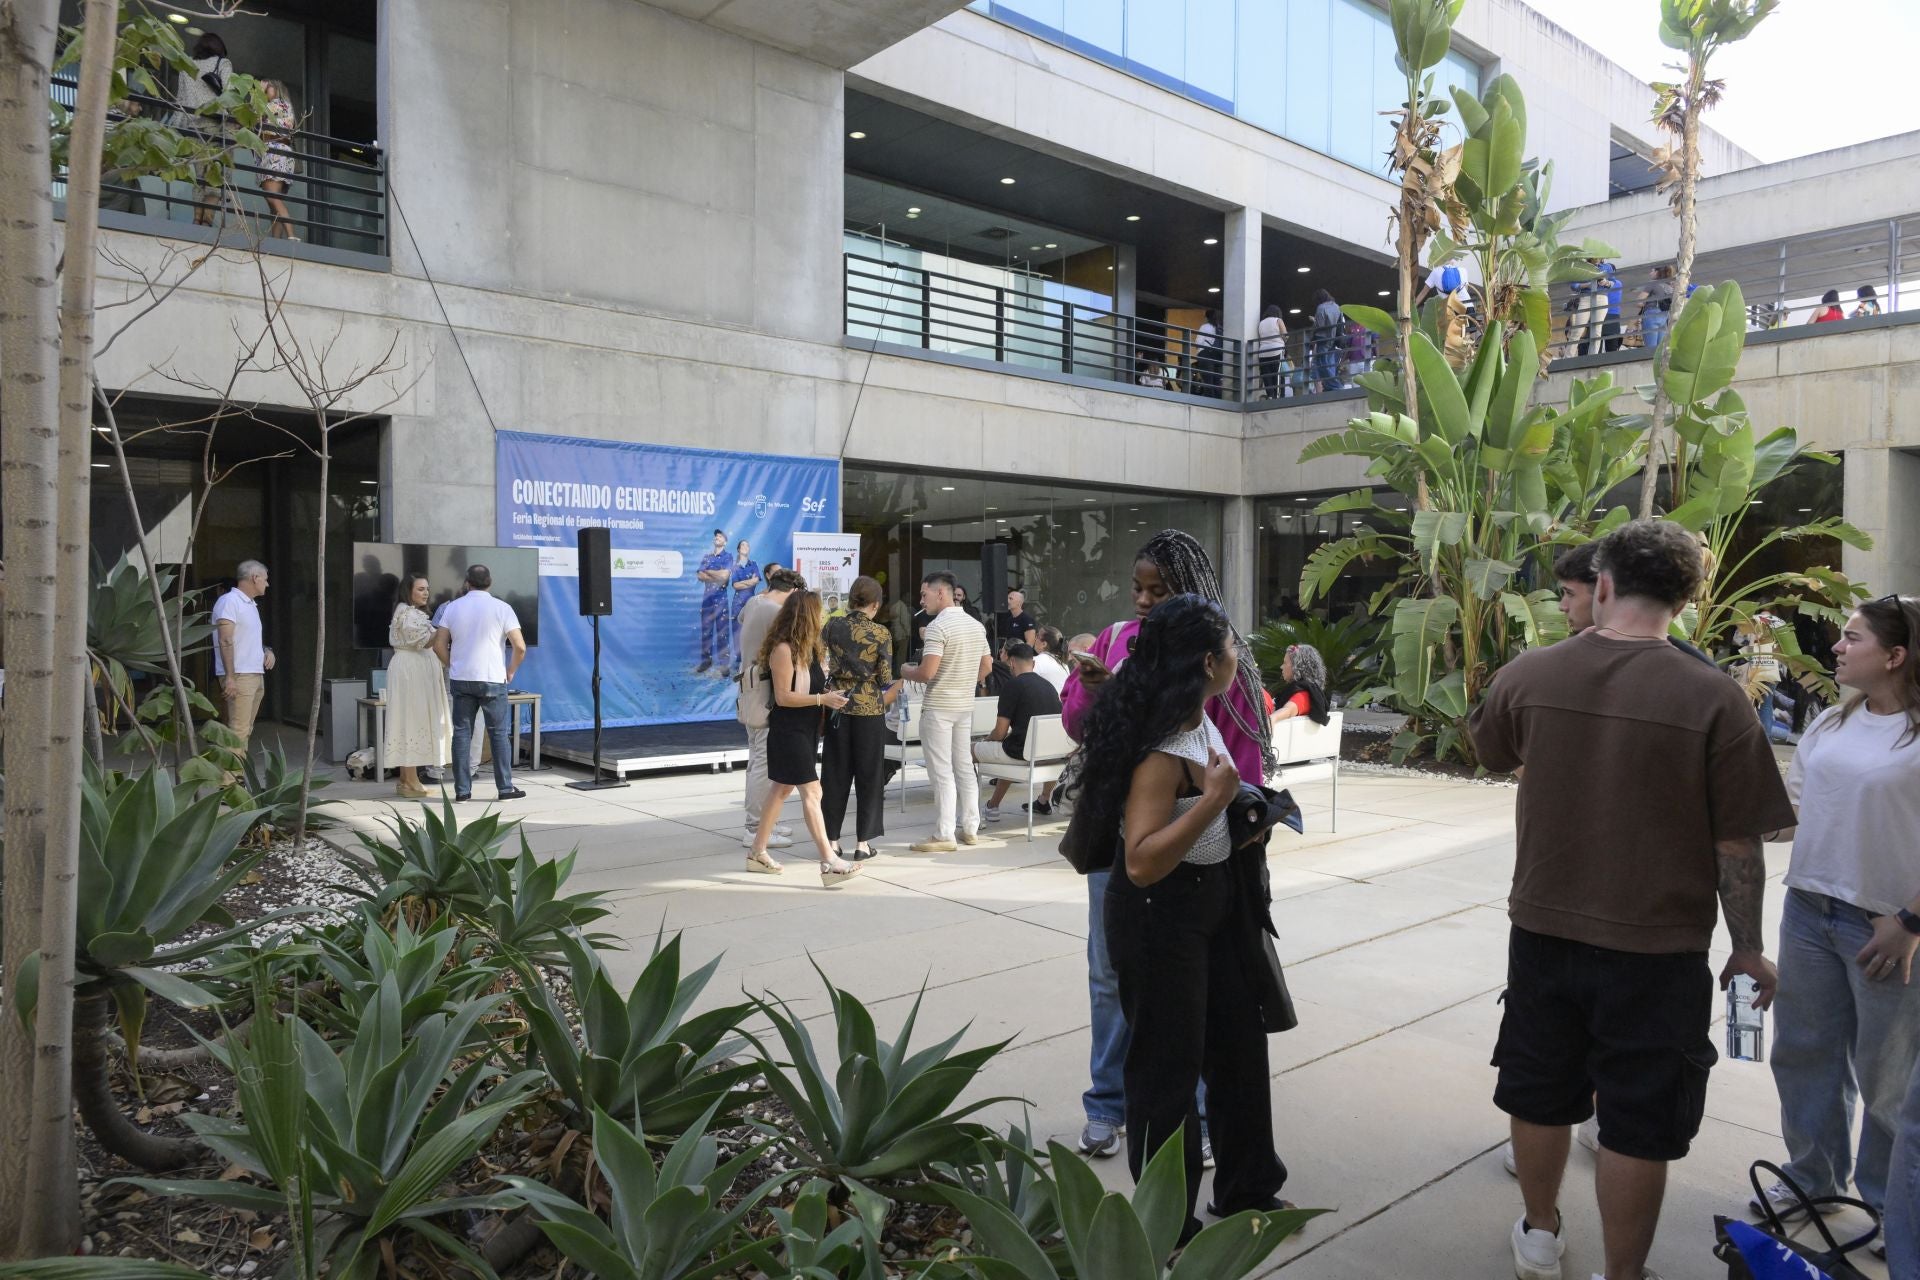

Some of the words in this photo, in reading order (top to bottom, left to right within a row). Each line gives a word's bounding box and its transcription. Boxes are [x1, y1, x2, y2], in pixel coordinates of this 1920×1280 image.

[512, 478, 612, 510] CONECTANDO
[615, 486, 716, 515] GENERACIONES
[802, 496, 826, 512] Sef
[512, 511, 533, 525] Feria
[533, 512, 565, 528] Regional
[565, 515, 575, 527] de
[576, 515, 602, 528] Empleo
[608, 516, 644, 530] Formación
